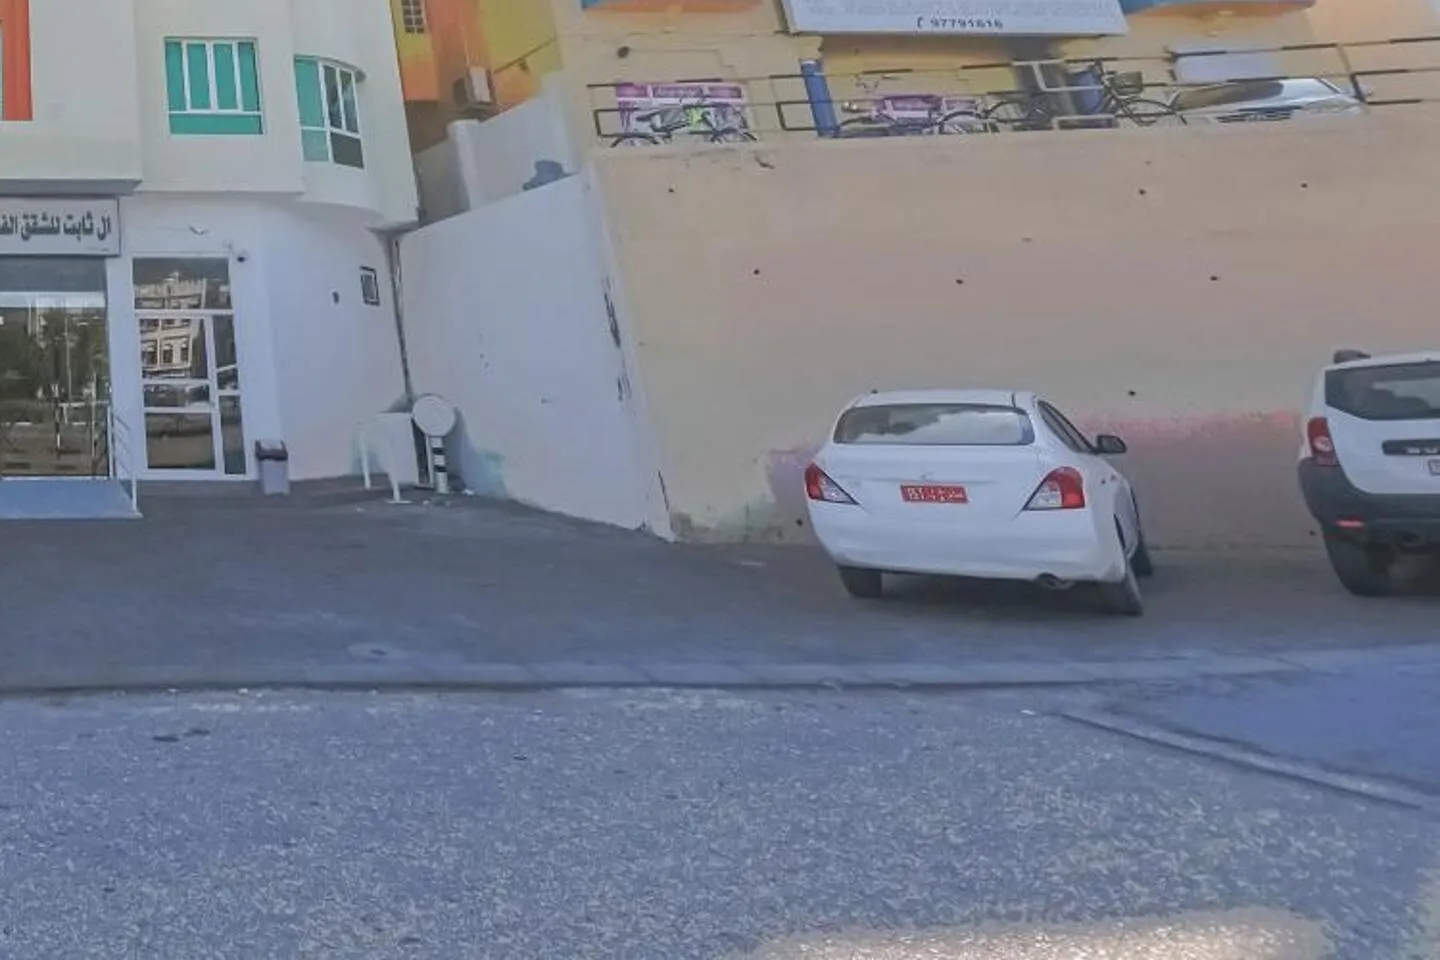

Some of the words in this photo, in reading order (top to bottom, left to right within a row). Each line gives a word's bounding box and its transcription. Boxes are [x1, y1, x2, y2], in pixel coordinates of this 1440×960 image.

[21, 211, 60, 242] للشقق
[63, 210, 94, 242] ثابت
[97, 214, 111, 241] ال
